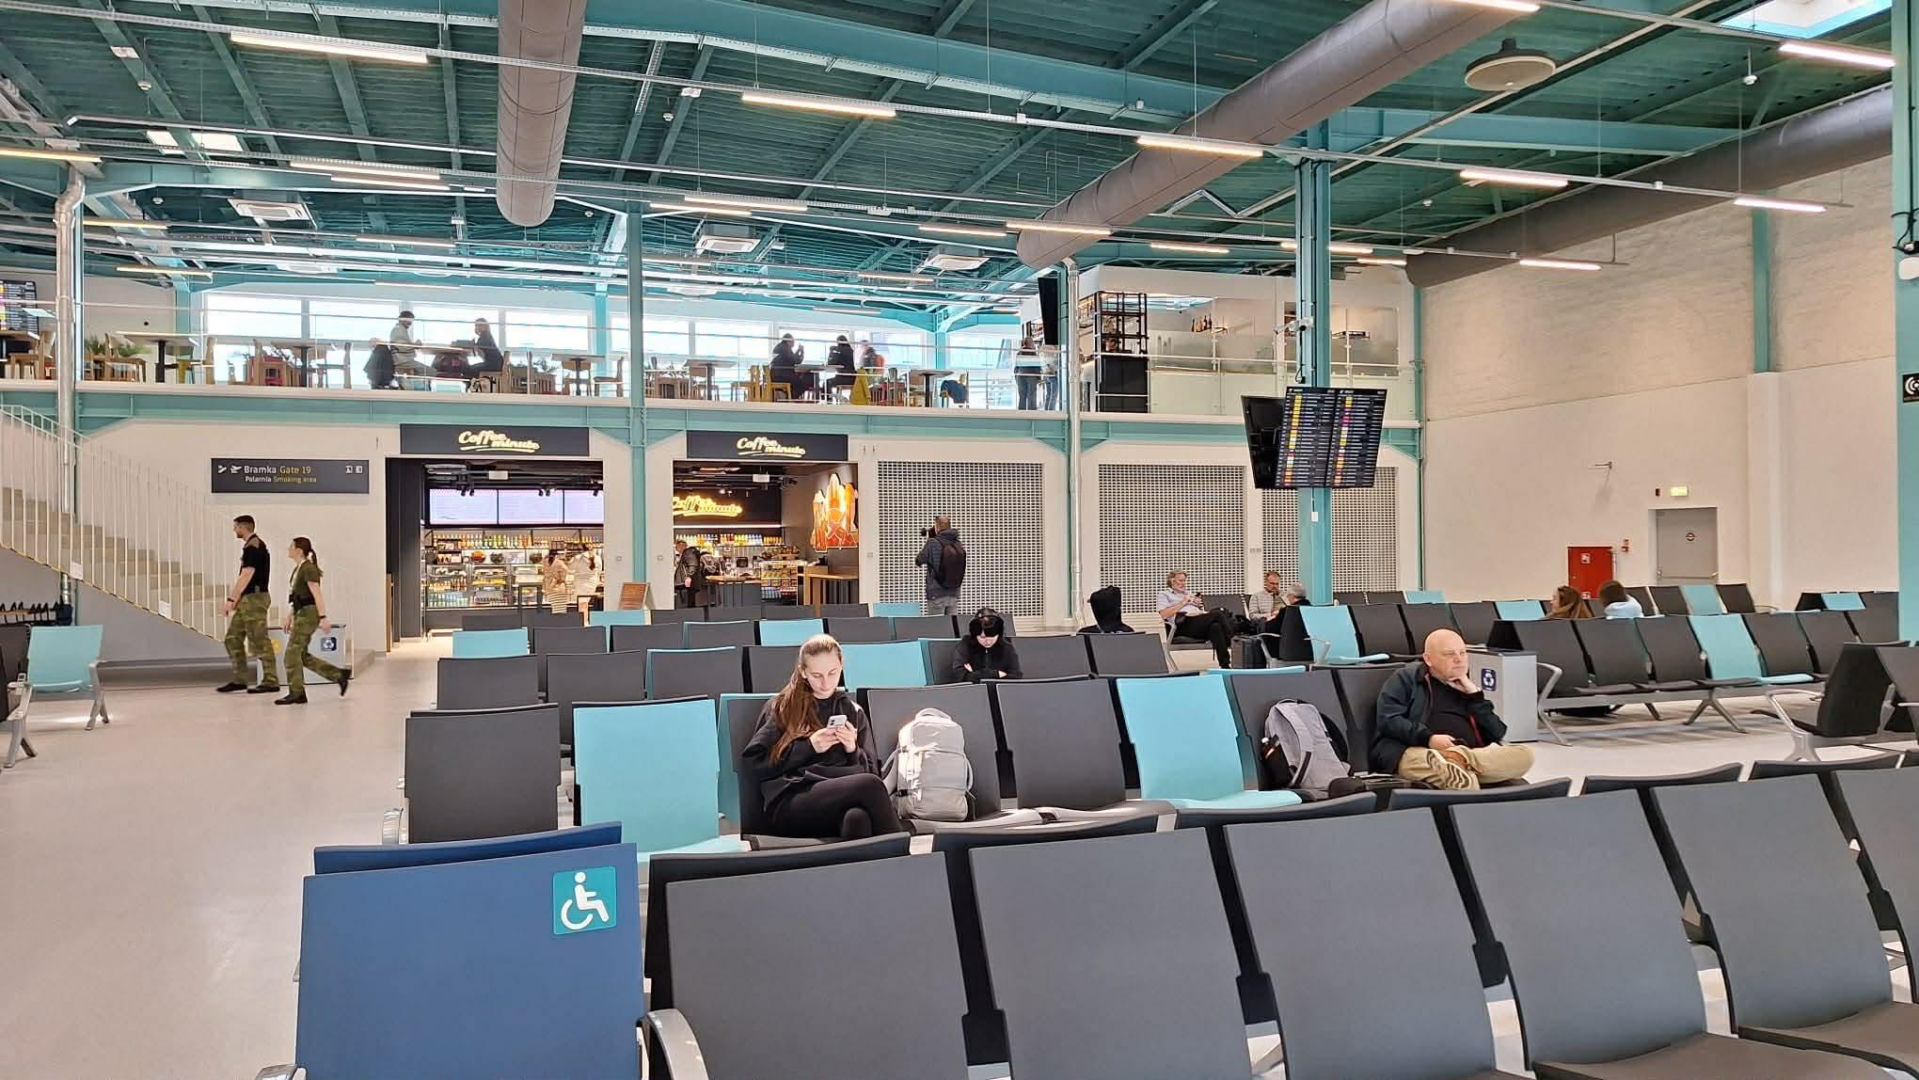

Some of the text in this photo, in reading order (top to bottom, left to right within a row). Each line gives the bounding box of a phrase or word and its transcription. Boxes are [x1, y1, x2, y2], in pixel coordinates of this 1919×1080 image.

[458, 430, 540, 450] Coffee minute
[737, 436, 806, 455] Coffee minute
[244, 465, 312, 474] Bramka Gate 19
